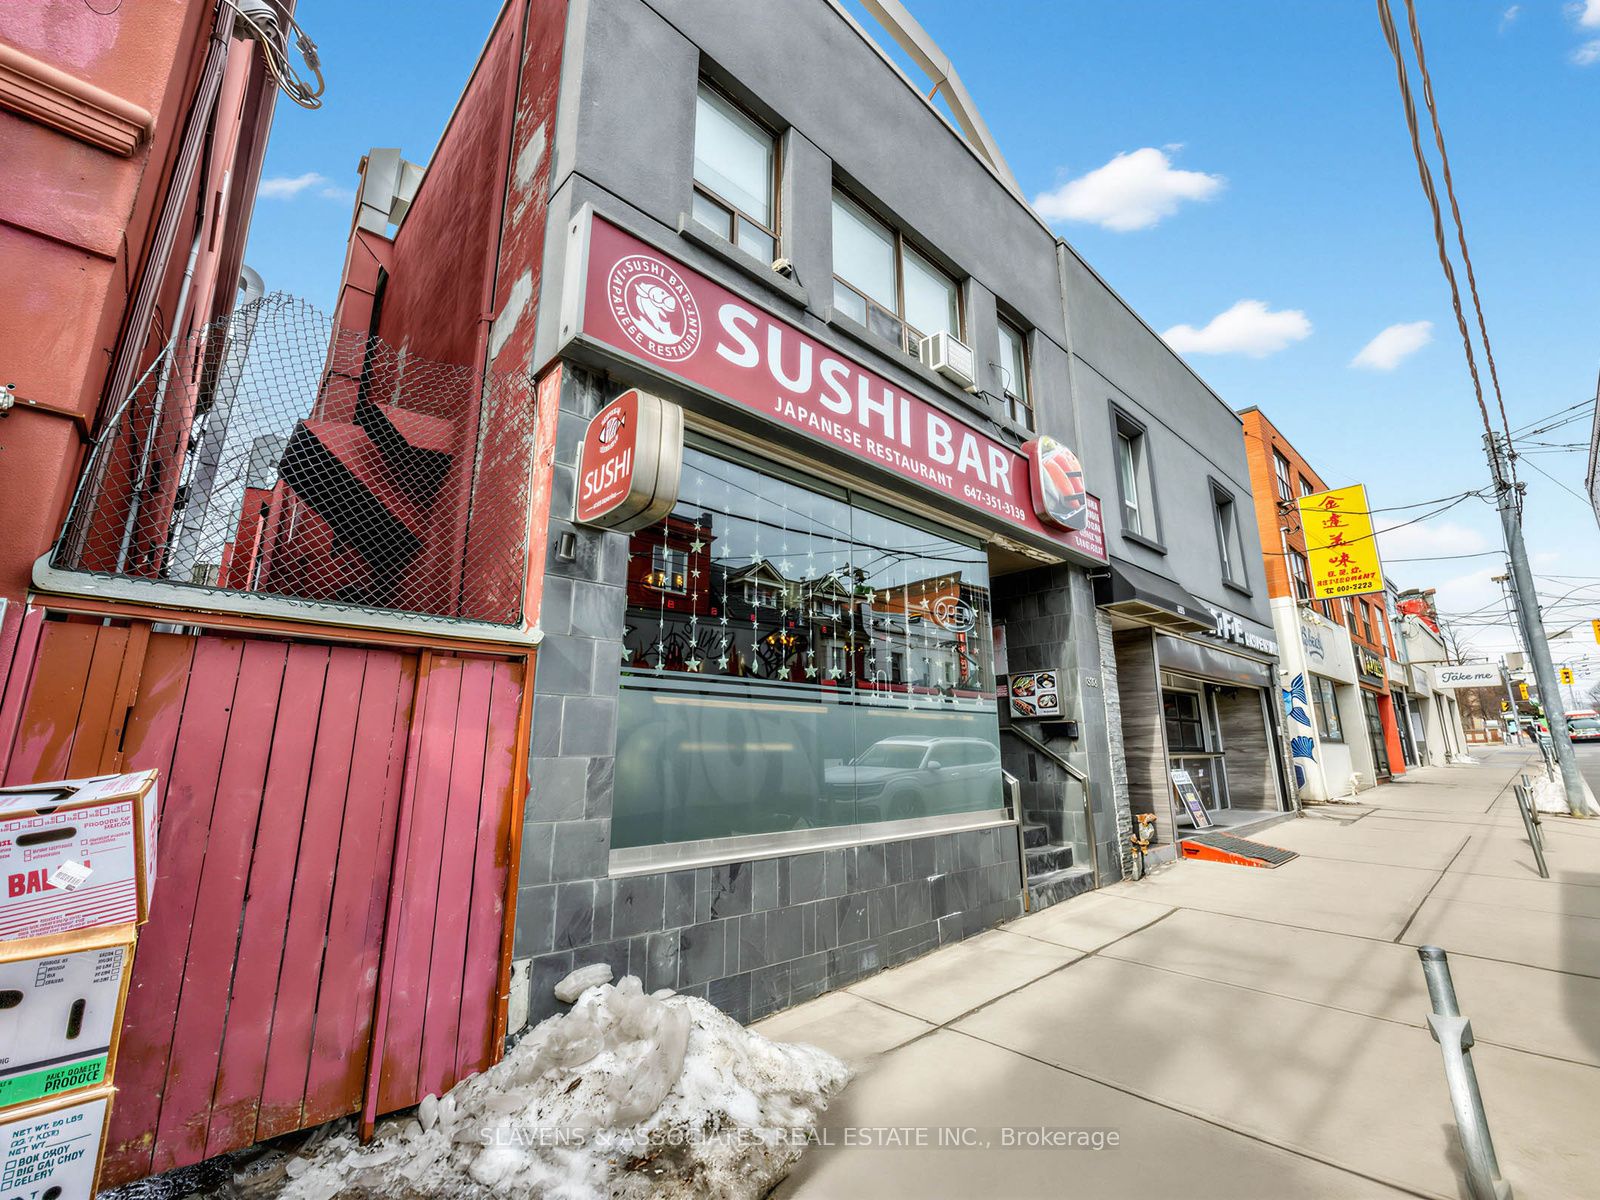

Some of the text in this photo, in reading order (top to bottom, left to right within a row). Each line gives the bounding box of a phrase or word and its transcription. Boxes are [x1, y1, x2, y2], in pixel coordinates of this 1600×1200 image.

[625, 260, 665, 278] SUSHI
[715, 303, 1012, 496] SUSHI BAR
[774, 396, 953, 489] JAPANESE RESTAURANT
[583, 446, 632, 500] SUSHI
[963, 484, 1026, 521] 647-351-3139
[12, 1127, 33, 1138] NET
[8, 1146, 29, 1157] NET
[37, 1158, 55, 1171] GAI
[57, 1148, 86, 1165] CHOY
[14, 1168, 55, 1187] CELERY
